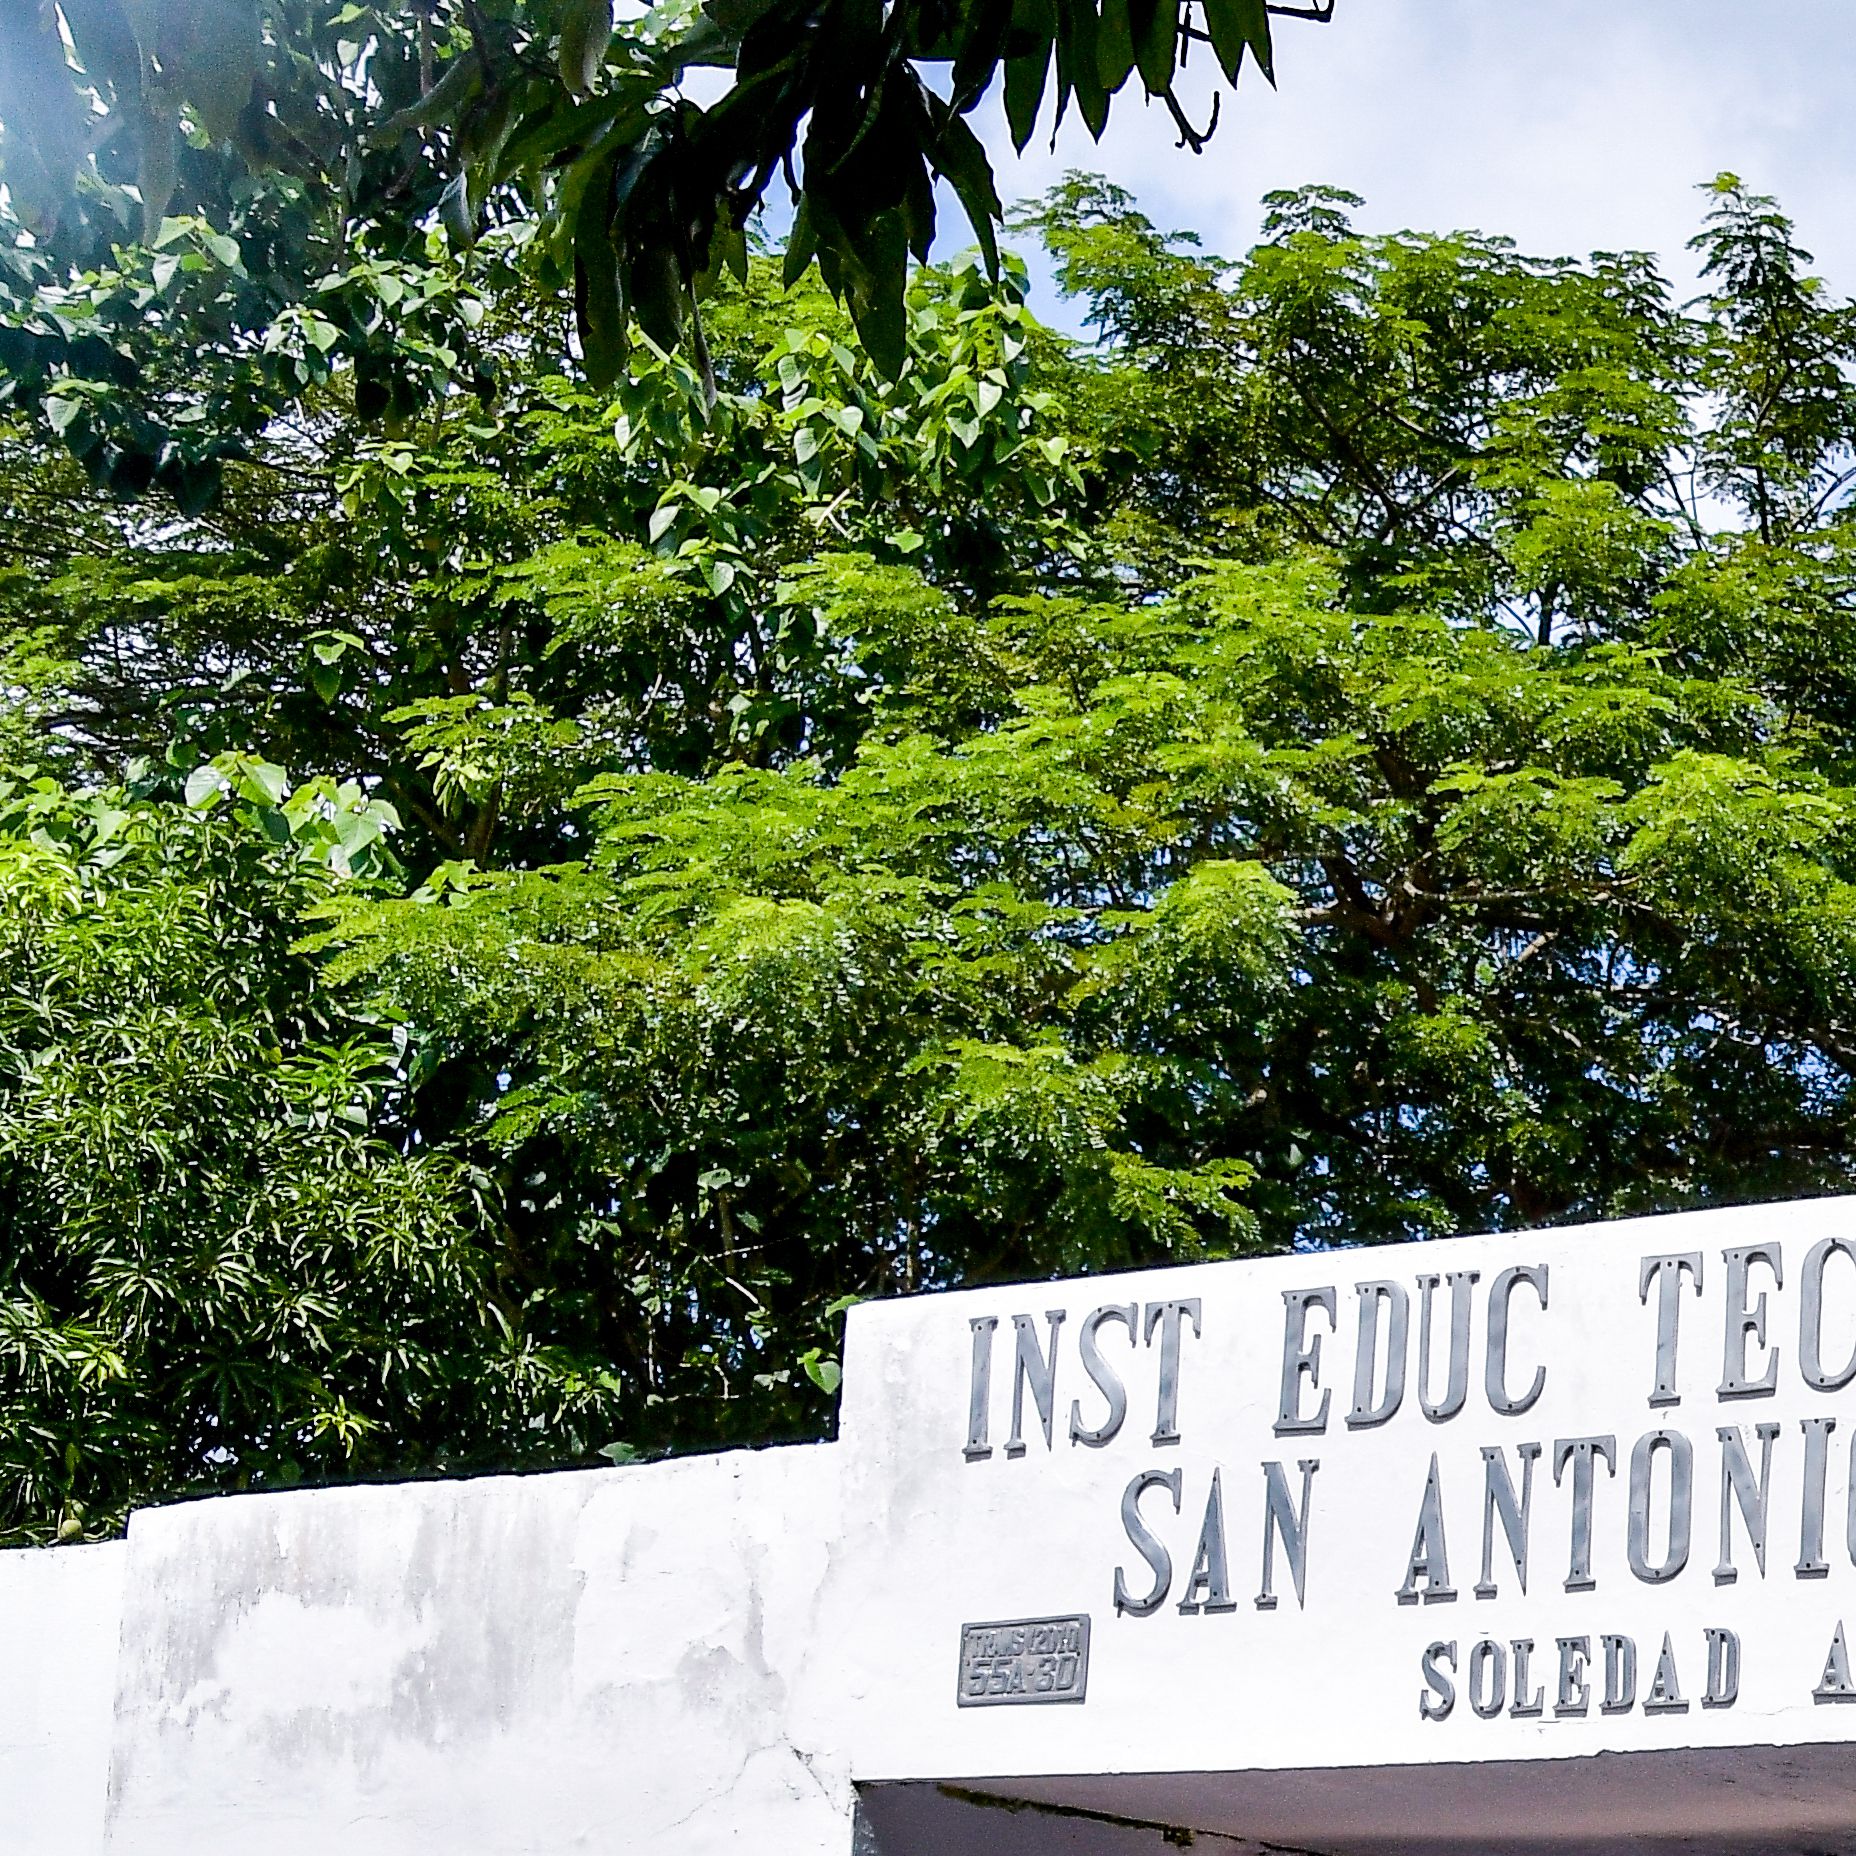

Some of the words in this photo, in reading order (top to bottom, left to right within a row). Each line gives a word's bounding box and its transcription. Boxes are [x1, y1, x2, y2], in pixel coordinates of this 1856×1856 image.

[964, 1297, 1202, 1462] INST
[1273, 1263, 1549, 1437] EDUC
[1112, 1458, 1320, 1618] SAN
[1418, 1626, 1741, 1721] SOLEDAD
